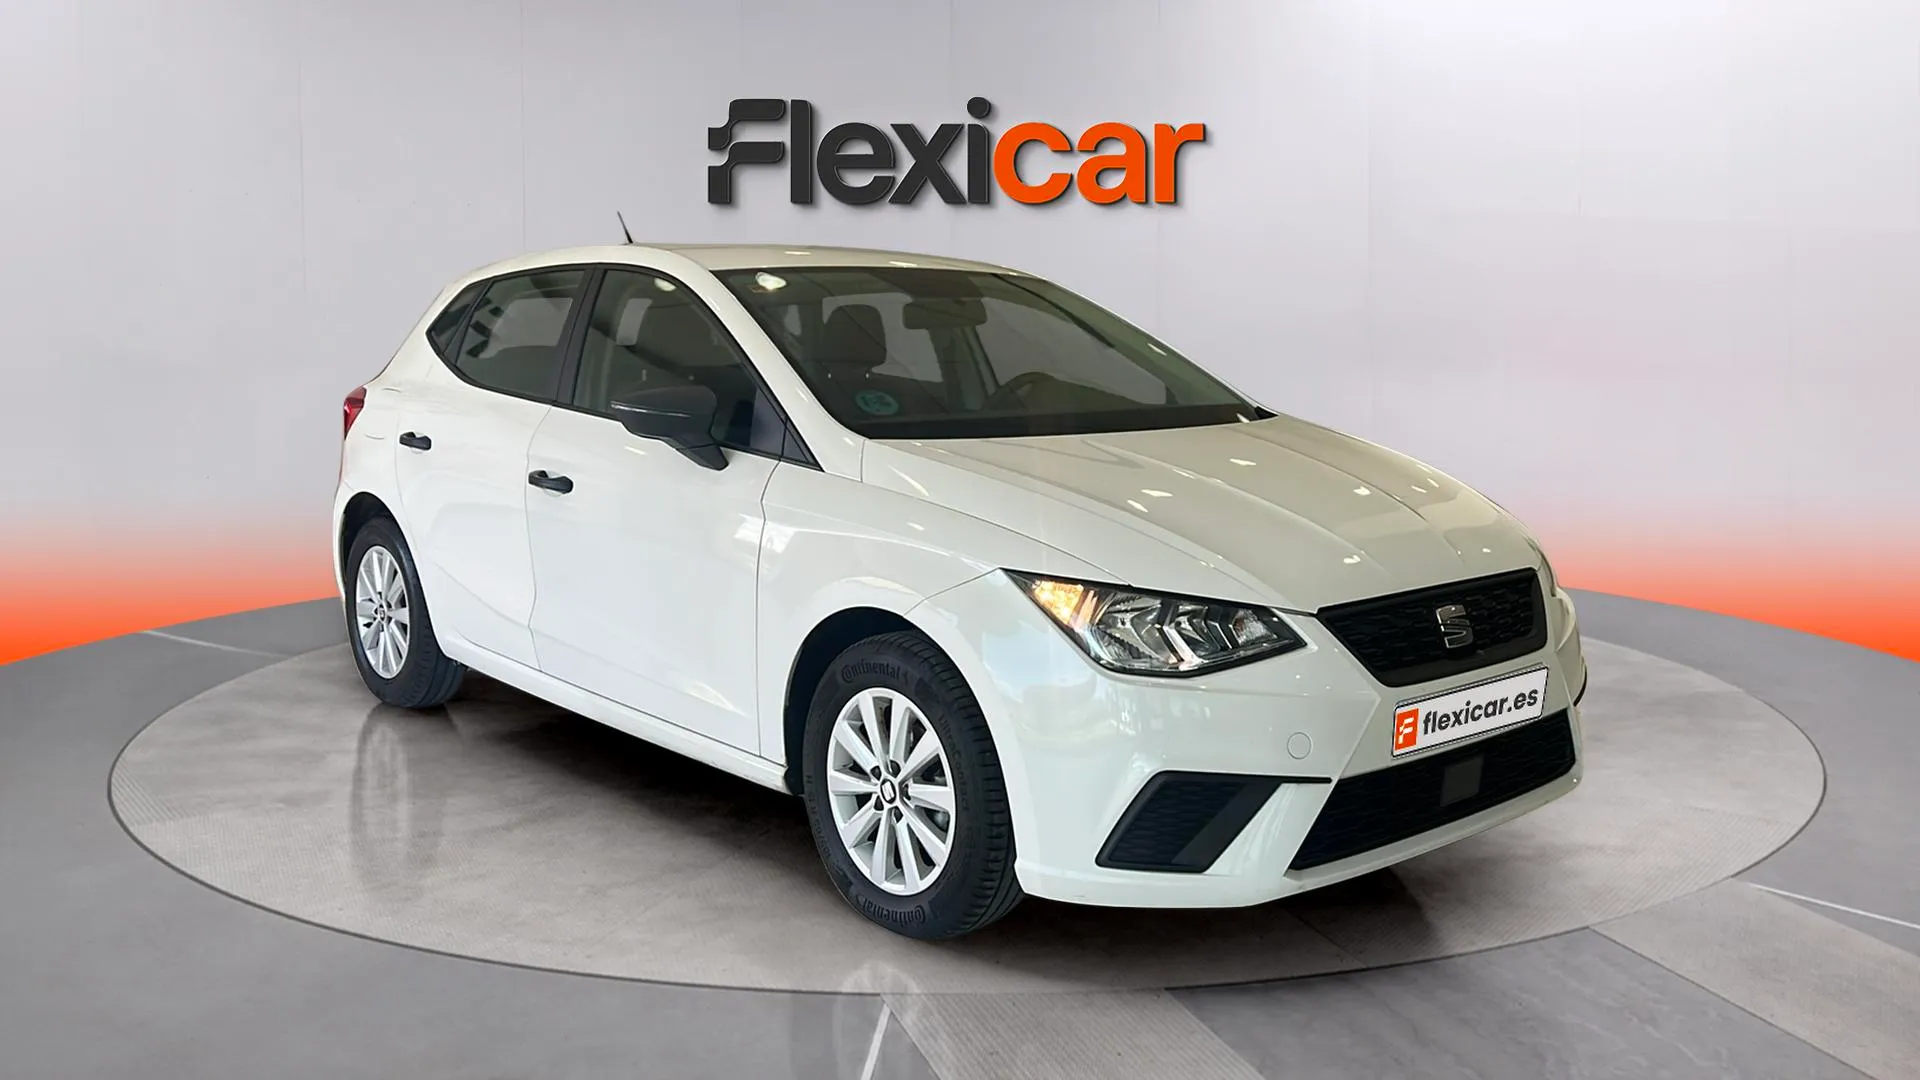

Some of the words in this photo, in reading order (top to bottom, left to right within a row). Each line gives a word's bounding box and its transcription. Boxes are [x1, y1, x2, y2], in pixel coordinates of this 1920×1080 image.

[707, 96, 1206, 205] Flexicar
[841, 657, 901, 684] Continental
[1422, 688, 1539, 735] flexicar.es
